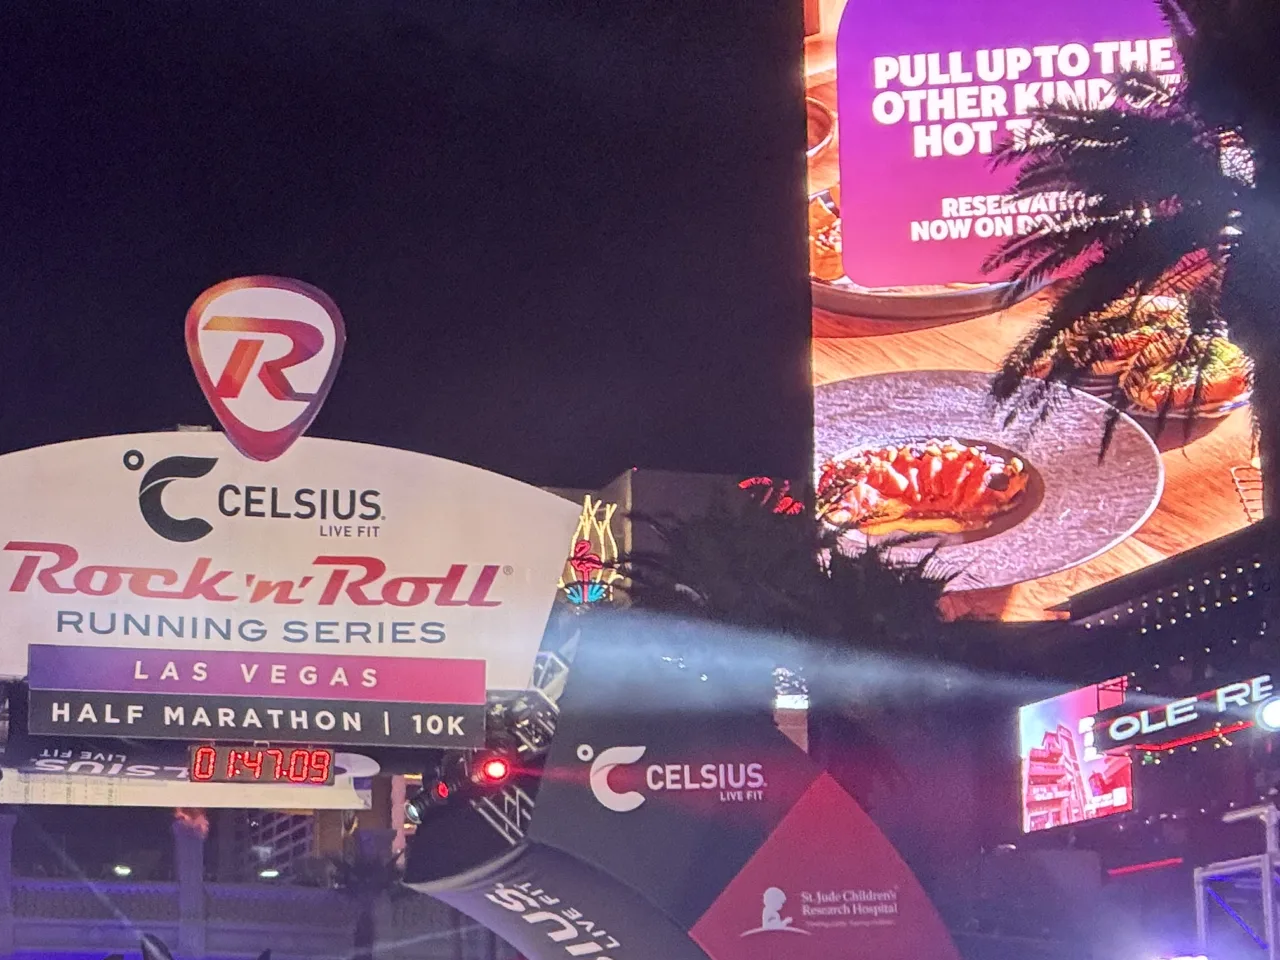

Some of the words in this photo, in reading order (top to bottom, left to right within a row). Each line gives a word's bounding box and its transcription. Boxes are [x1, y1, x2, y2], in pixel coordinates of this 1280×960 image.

[874, 51, 972, 89] PULL
[977, 47, 1032, 82] UP
[1034, 43, 1090, 78] TO
[1093, 37, 1175, 75] THE
[872, 84, 1008, 124] OTHER
[913, 120, 997, 158] HOT
[910, 217, 974, 242] NOW
[975, 215, 1014, 240] ON
[320, 525, 352, 538] LIVE
[357, 525, 381, 538] FIT
[3, 540, 239, 602] Rock
[312, 555, 503, 607] Roll
[57, 610, 268, 643] RUNNING
[283, 620, 447, 644] SERIES
[133, 659, 209, 682] LAS
[240, 663, 379, 688] VEGAS
[51, 701, 145, 726] HALF
[163, 704, 363, 733] MARATHON
[412, 713, 467, 737] 10K
[1109, 697, 1199, 741] OLE
[720, 791, 743, 802] LIVE
[746, 790, 765, 801] FIT
[802, 903, 851, 916] Research
[853, 902, 898, 917] Hospital
[816, 889, 841, 904] Jude
[561, 907, 620, 950] LIVE
